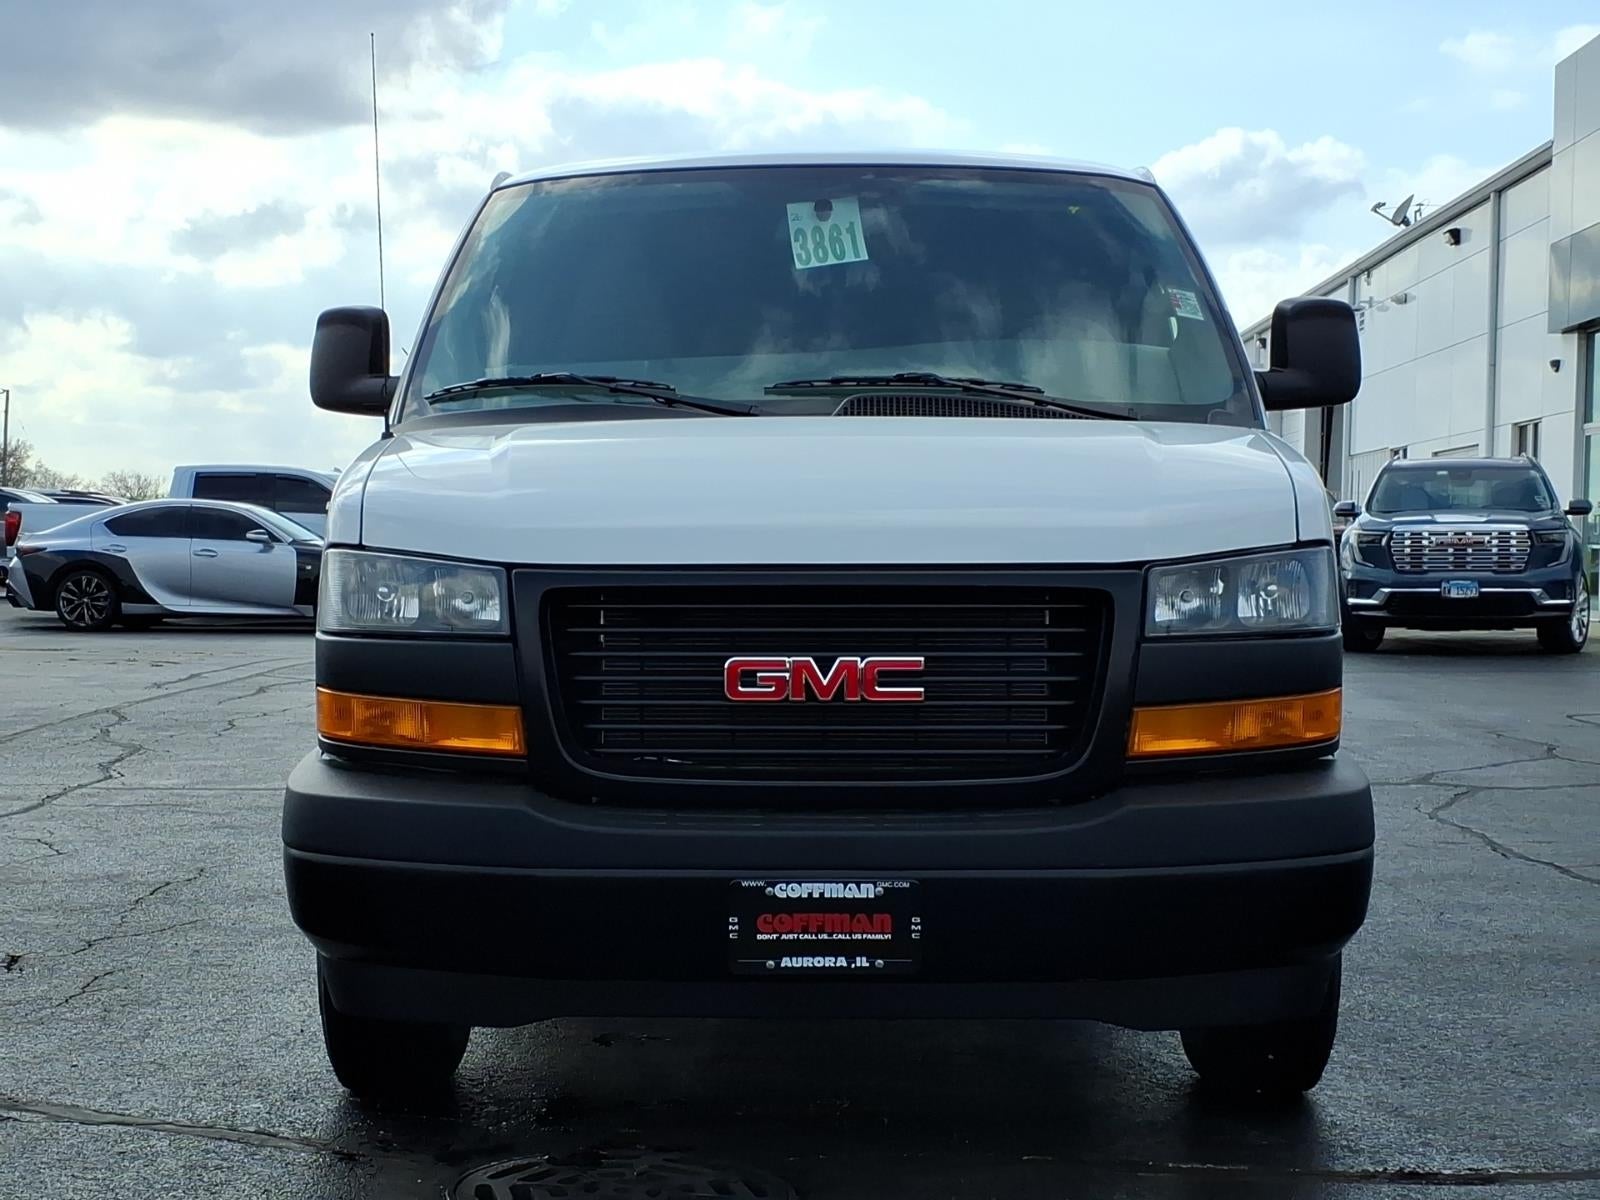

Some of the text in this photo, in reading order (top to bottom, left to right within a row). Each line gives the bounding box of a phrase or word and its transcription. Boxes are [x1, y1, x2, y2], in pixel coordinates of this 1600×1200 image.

[793, 221, 862, 266] 3861
[724, 656, 925, 701] GMC
[774, 883, 875, 898] COFFMAN
[757, 913, 892, 933] COFFMAN
[780, 956, 848, 968] AURORA
